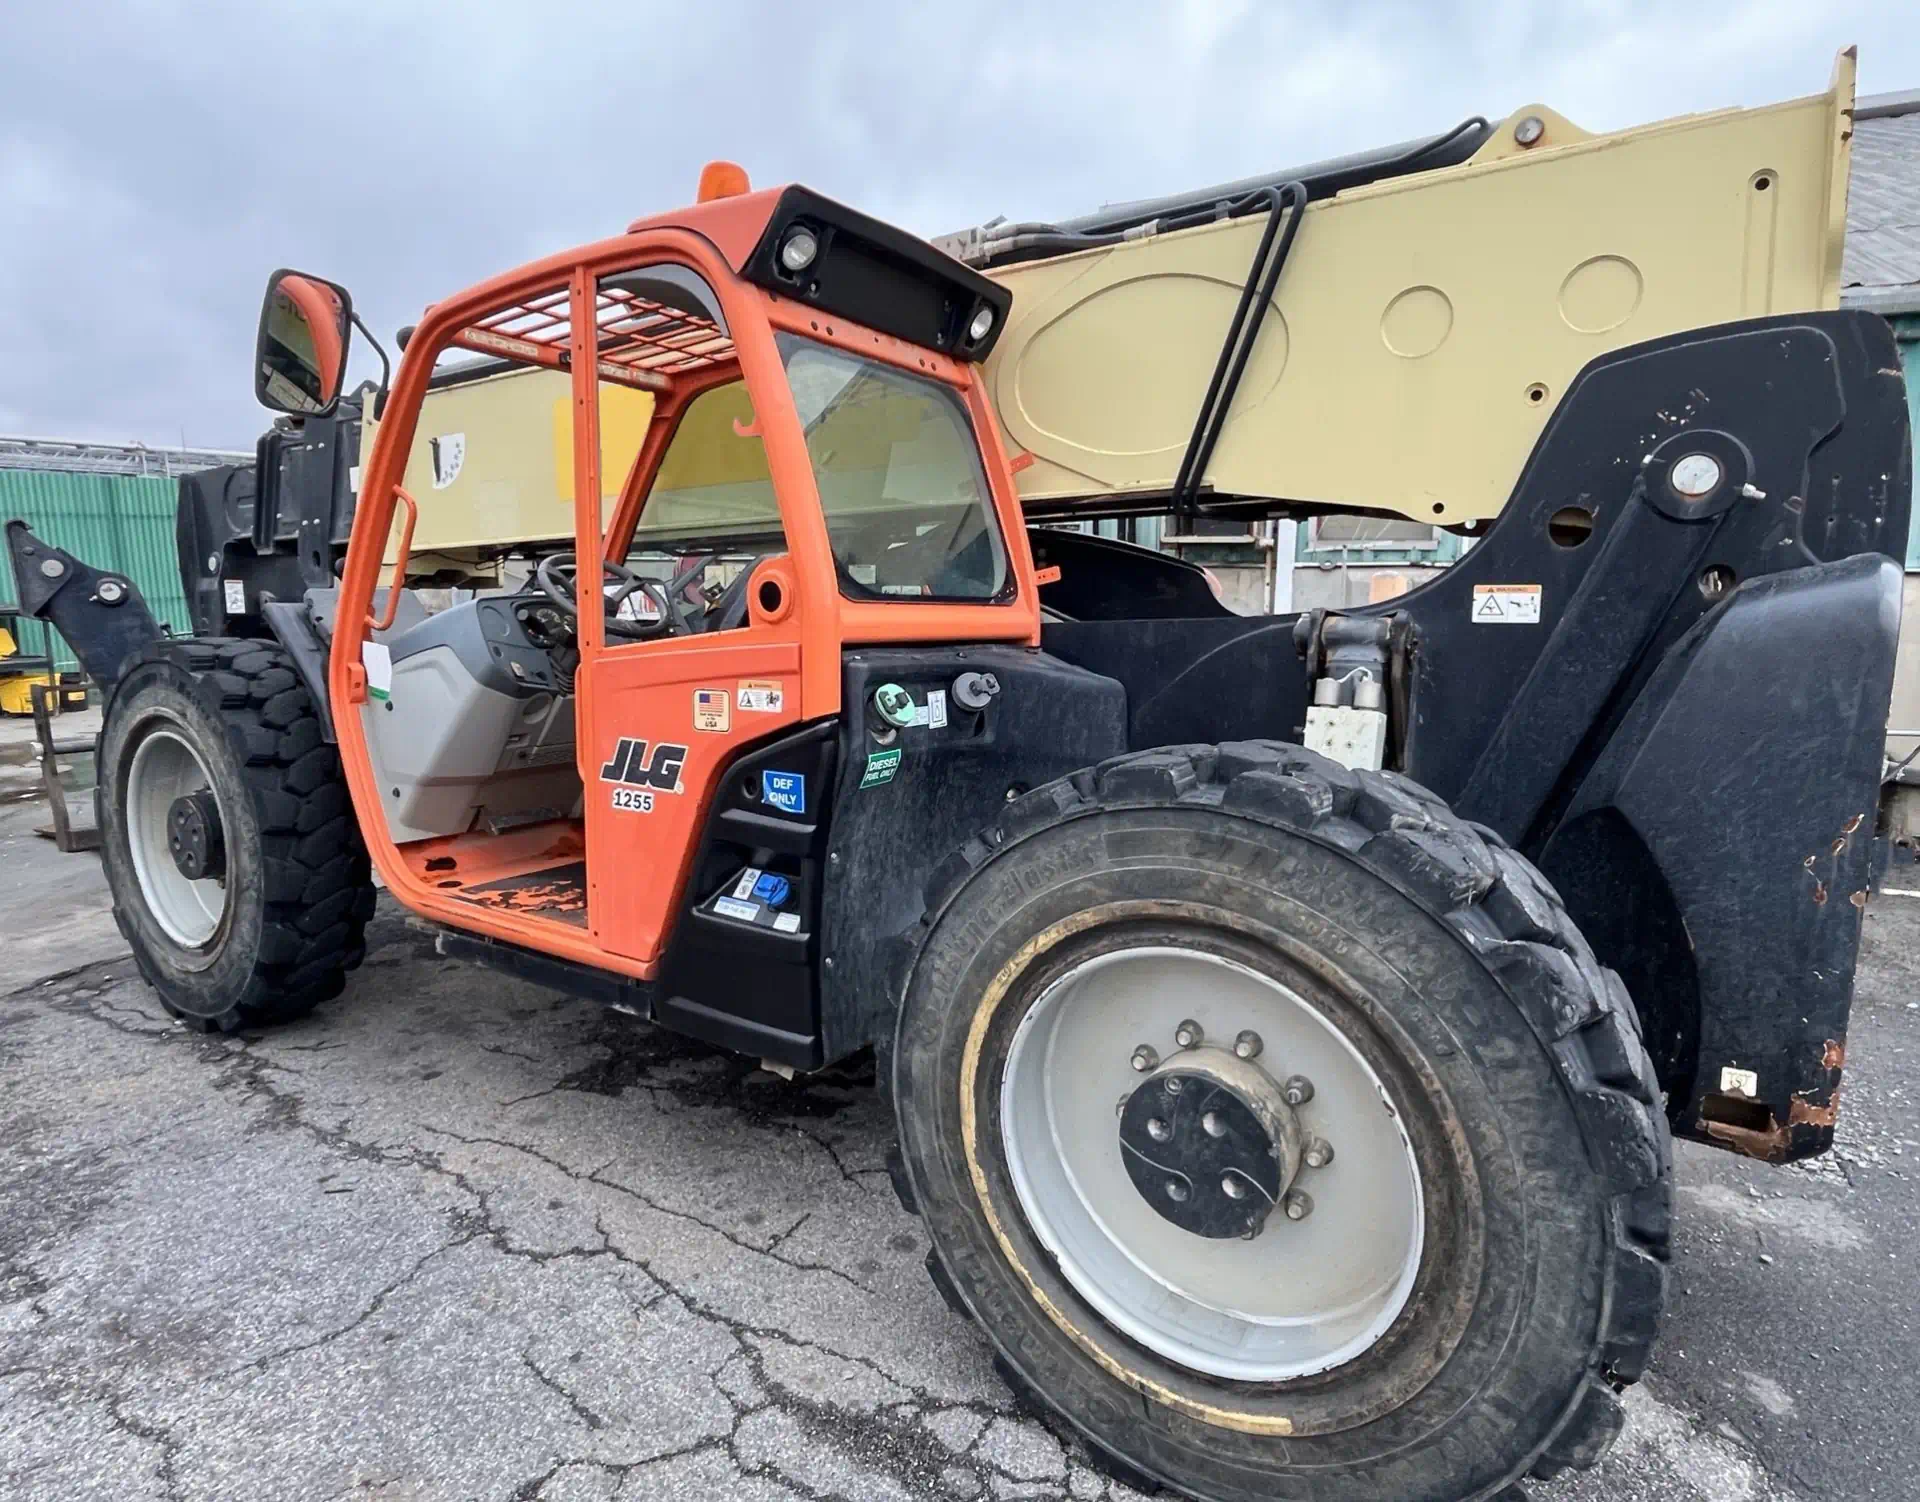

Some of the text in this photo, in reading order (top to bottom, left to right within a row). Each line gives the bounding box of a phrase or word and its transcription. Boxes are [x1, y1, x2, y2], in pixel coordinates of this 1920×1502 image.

[601, 738, 687, 791] JLG
[869, 757, 898, 771] DIESEL
[773, 777, 794, 790] DEF
[614, 790, 652, 811] 1255
[769, 791, 797, 805] ONLY
